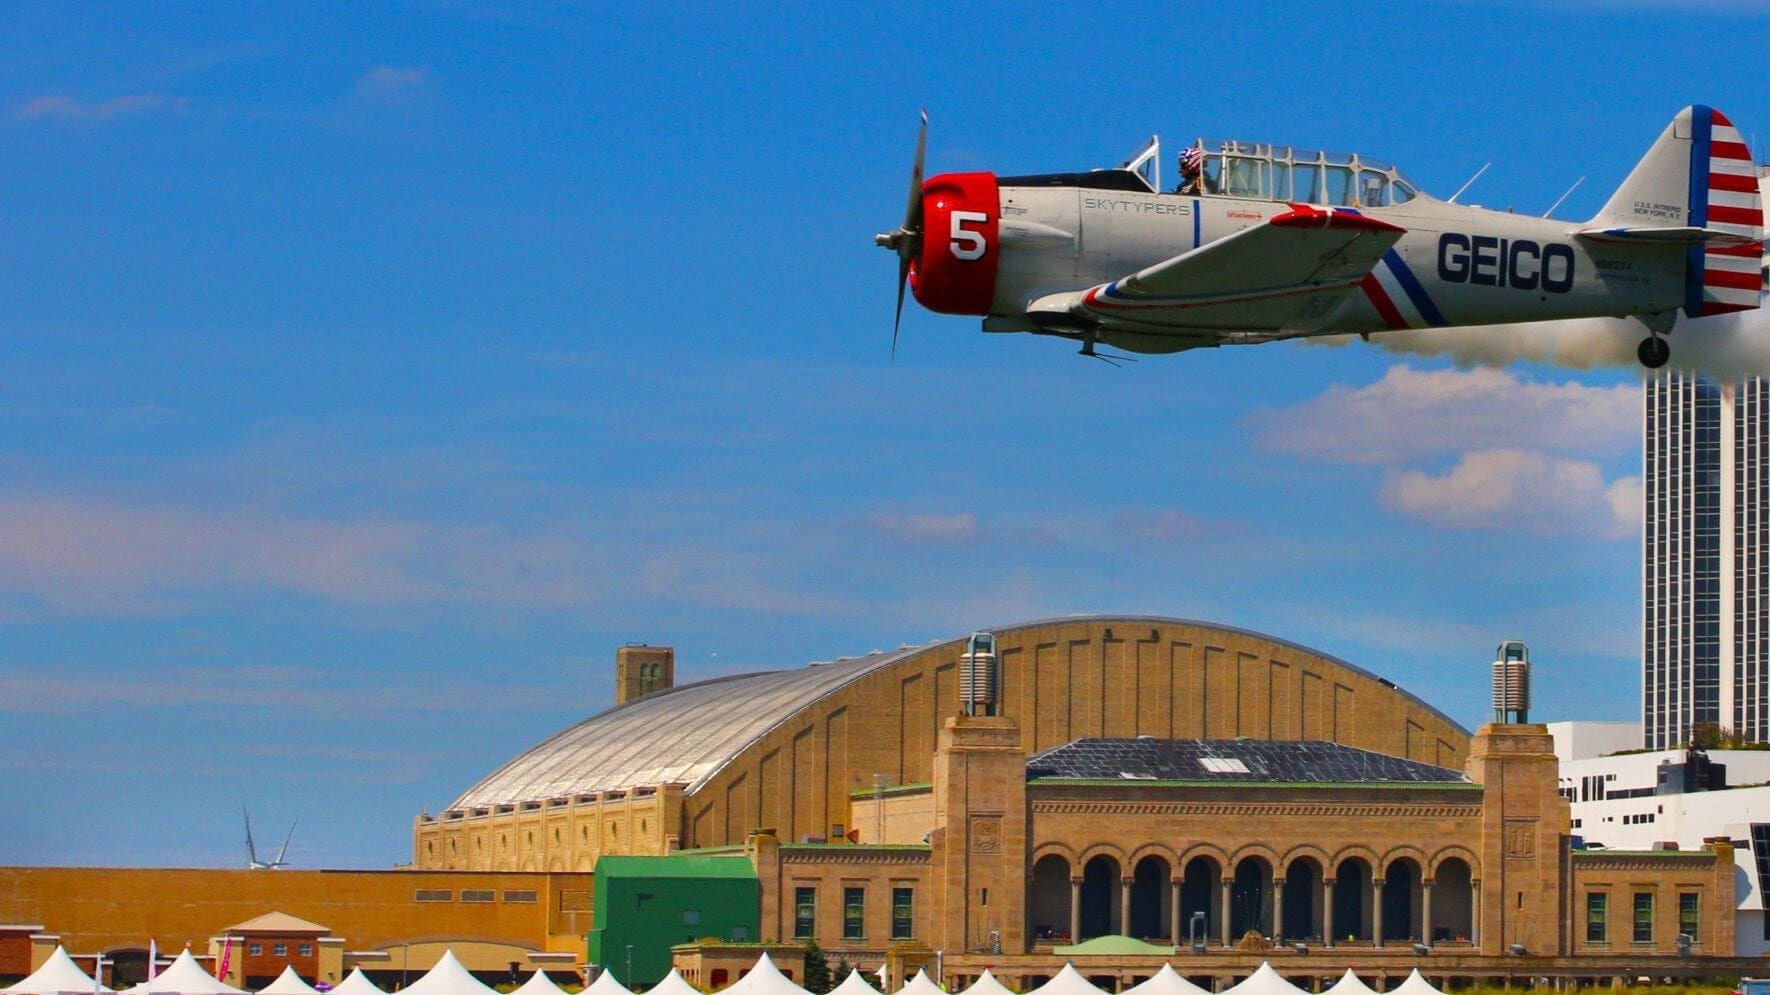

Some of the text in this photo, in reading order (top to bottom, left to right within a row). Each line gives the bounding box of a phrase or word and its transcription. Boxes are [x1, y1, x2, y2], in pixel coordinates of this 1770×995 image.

[1085, 198, 1190, 216] SKYTYPERS
[1633, 207, 1648, 215] NEW
[950, 210, 987, 260] 5
[1437, 232, 1575, 294] GEICO
